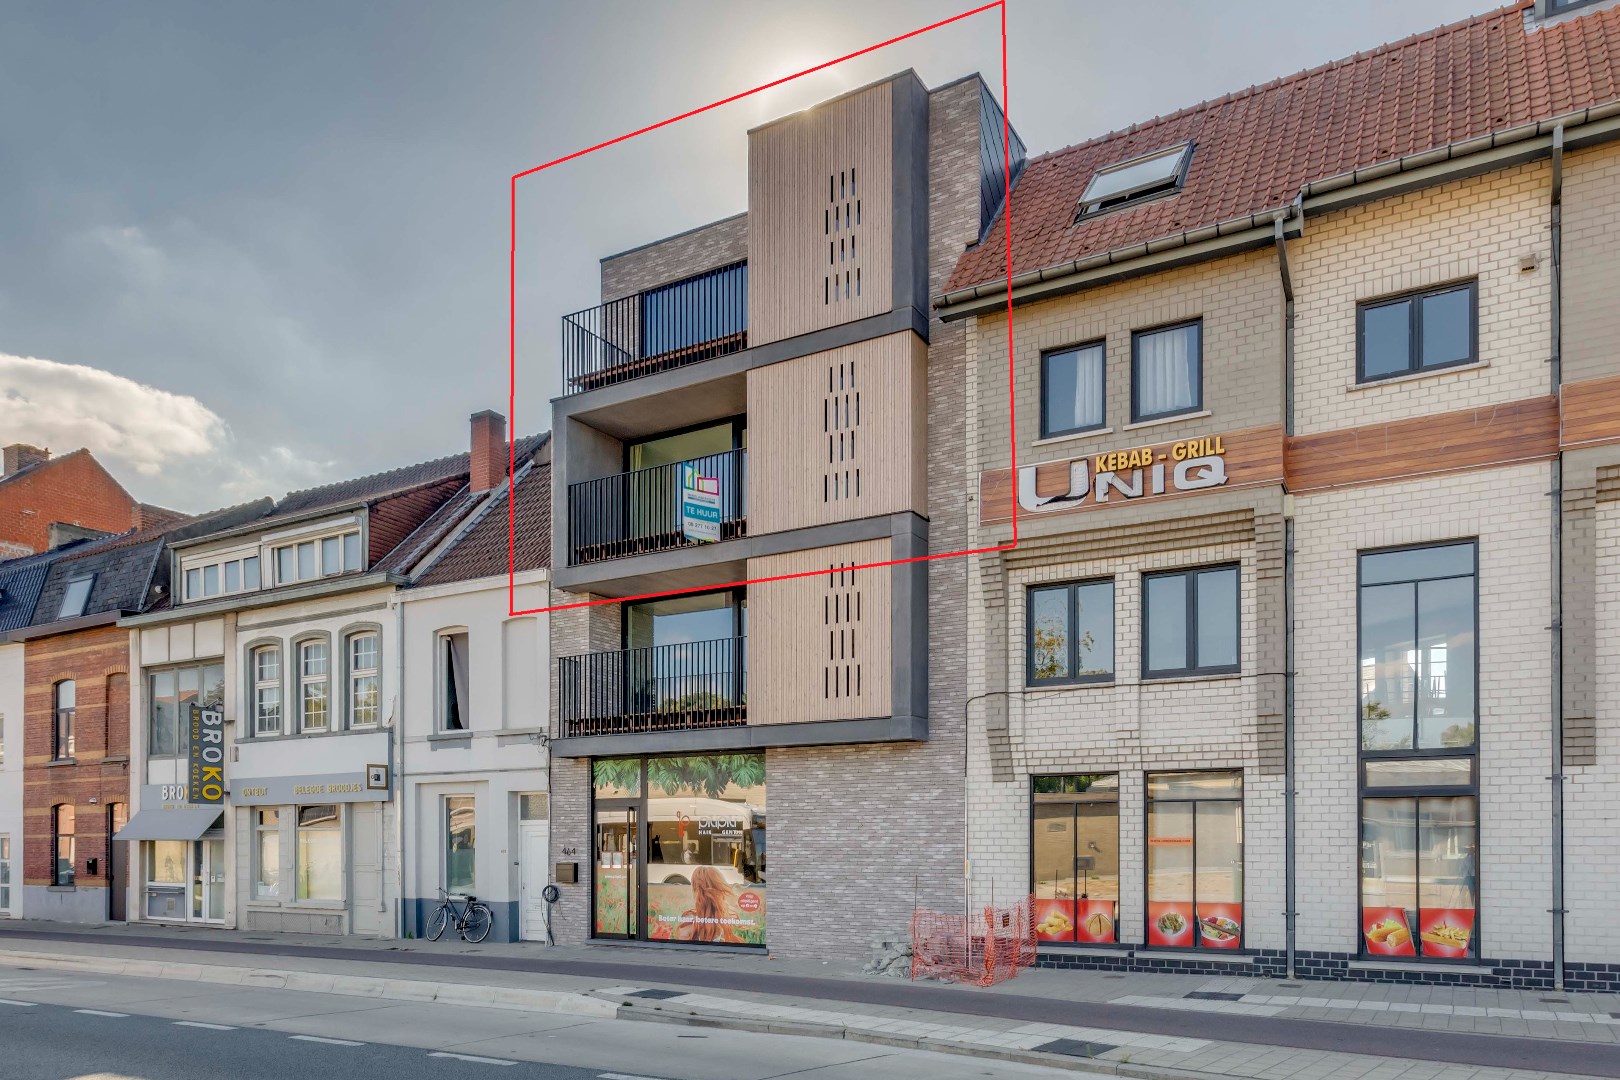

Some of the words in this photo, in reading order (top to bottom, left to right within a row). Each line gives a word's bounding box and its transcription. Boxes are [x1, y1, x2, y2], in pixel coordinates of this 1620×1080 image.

[1095, 448, 1153, 473] KEBAB
[1172, 436, 1225, 461] GRILL
[1018, 455, 1229, 513] UNIQ
[686, 505, 695, 515] TE
[697, 508, 718, 519] HUUR
[192, 709, 200, 740] BROOD
[192, 745, 200, 758] EN
[202, 710, 222, 800] BROKO
[162, 785, 189, 800] BRO
[192, 763, 200, 800] KOEKEN
[562, 847, 576, 855] 464
